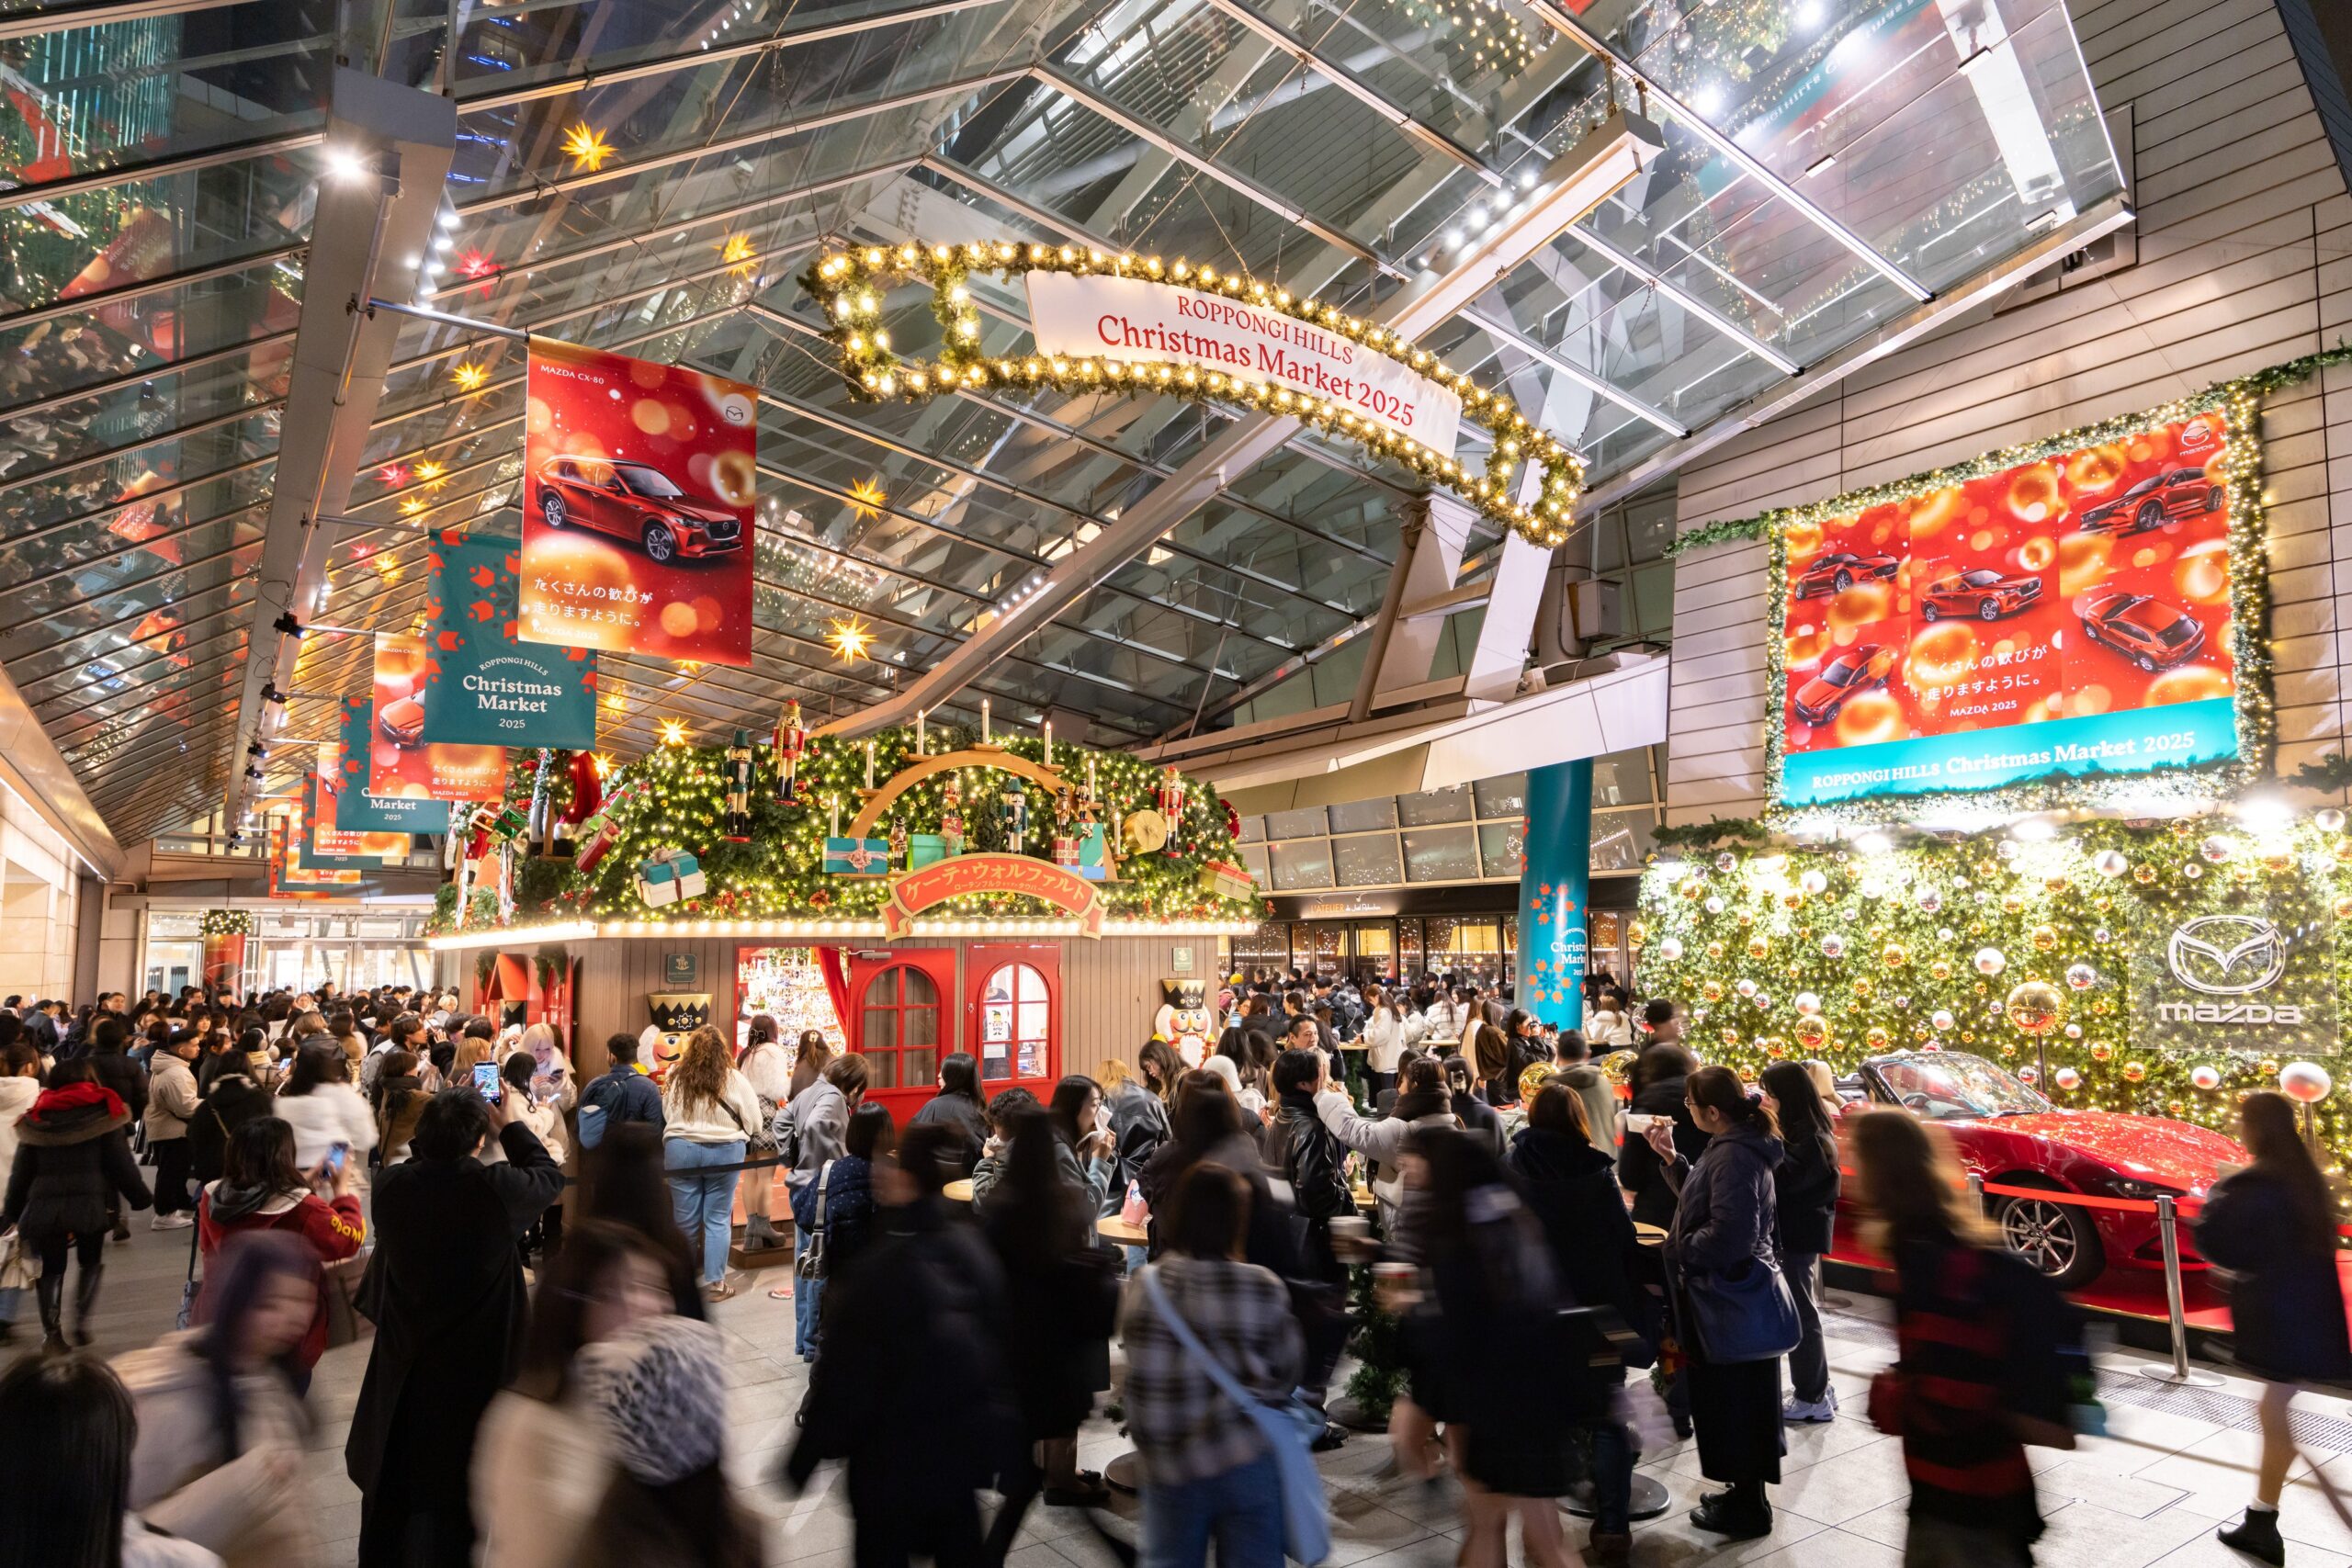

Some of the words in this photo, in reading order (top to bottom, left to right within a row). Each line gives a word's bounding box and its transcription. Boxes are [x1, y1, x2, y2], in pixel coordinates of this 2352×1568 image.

[1177, 295, 1289, 344] ROPPONGI
[1293, 325, 1353, 365] HILLS
[540, 365, 575, 378] MAZDA
[577, 372, 605, 385] CX-80
[1097, 314, 1251, 367] Christmas
[1256, 343, 1355, 401] Market
[1357, 382, 1416, 426] 2025
[535, 577, 653, 604] たくさんの歓びが
[532, 601, 640, 626] 走りますように。
[532, 626, 573, 637] MAZDA
[574, 628, 599, 640] 2025
[479, 656, 524, 671] ROPPONGI
[524, 660, 548, 676] HILLS
[462, 674, 562, 696] Christmas
[1927, 673, 2040, 701] 走りますように。
[477, 694, 548, 713] Market
[1950, 705, 1990, 717] MAZDA
[1992, 699, 2018, 712] 2025
[499, 717, 526, 728] 2025
[1813, 769, 1890, 789] ROPPONGI
[1892, 762, 1941, 780] HILLS
[1946, 750, 2052, 774] Christmas
[2054, 739, 2137, 762] Market
[2143, 731, 2195, 753] 2025
[370, 798, 417, 810] Market
[905, 862, 1085, 901] ケーテ・ウォルファルト
